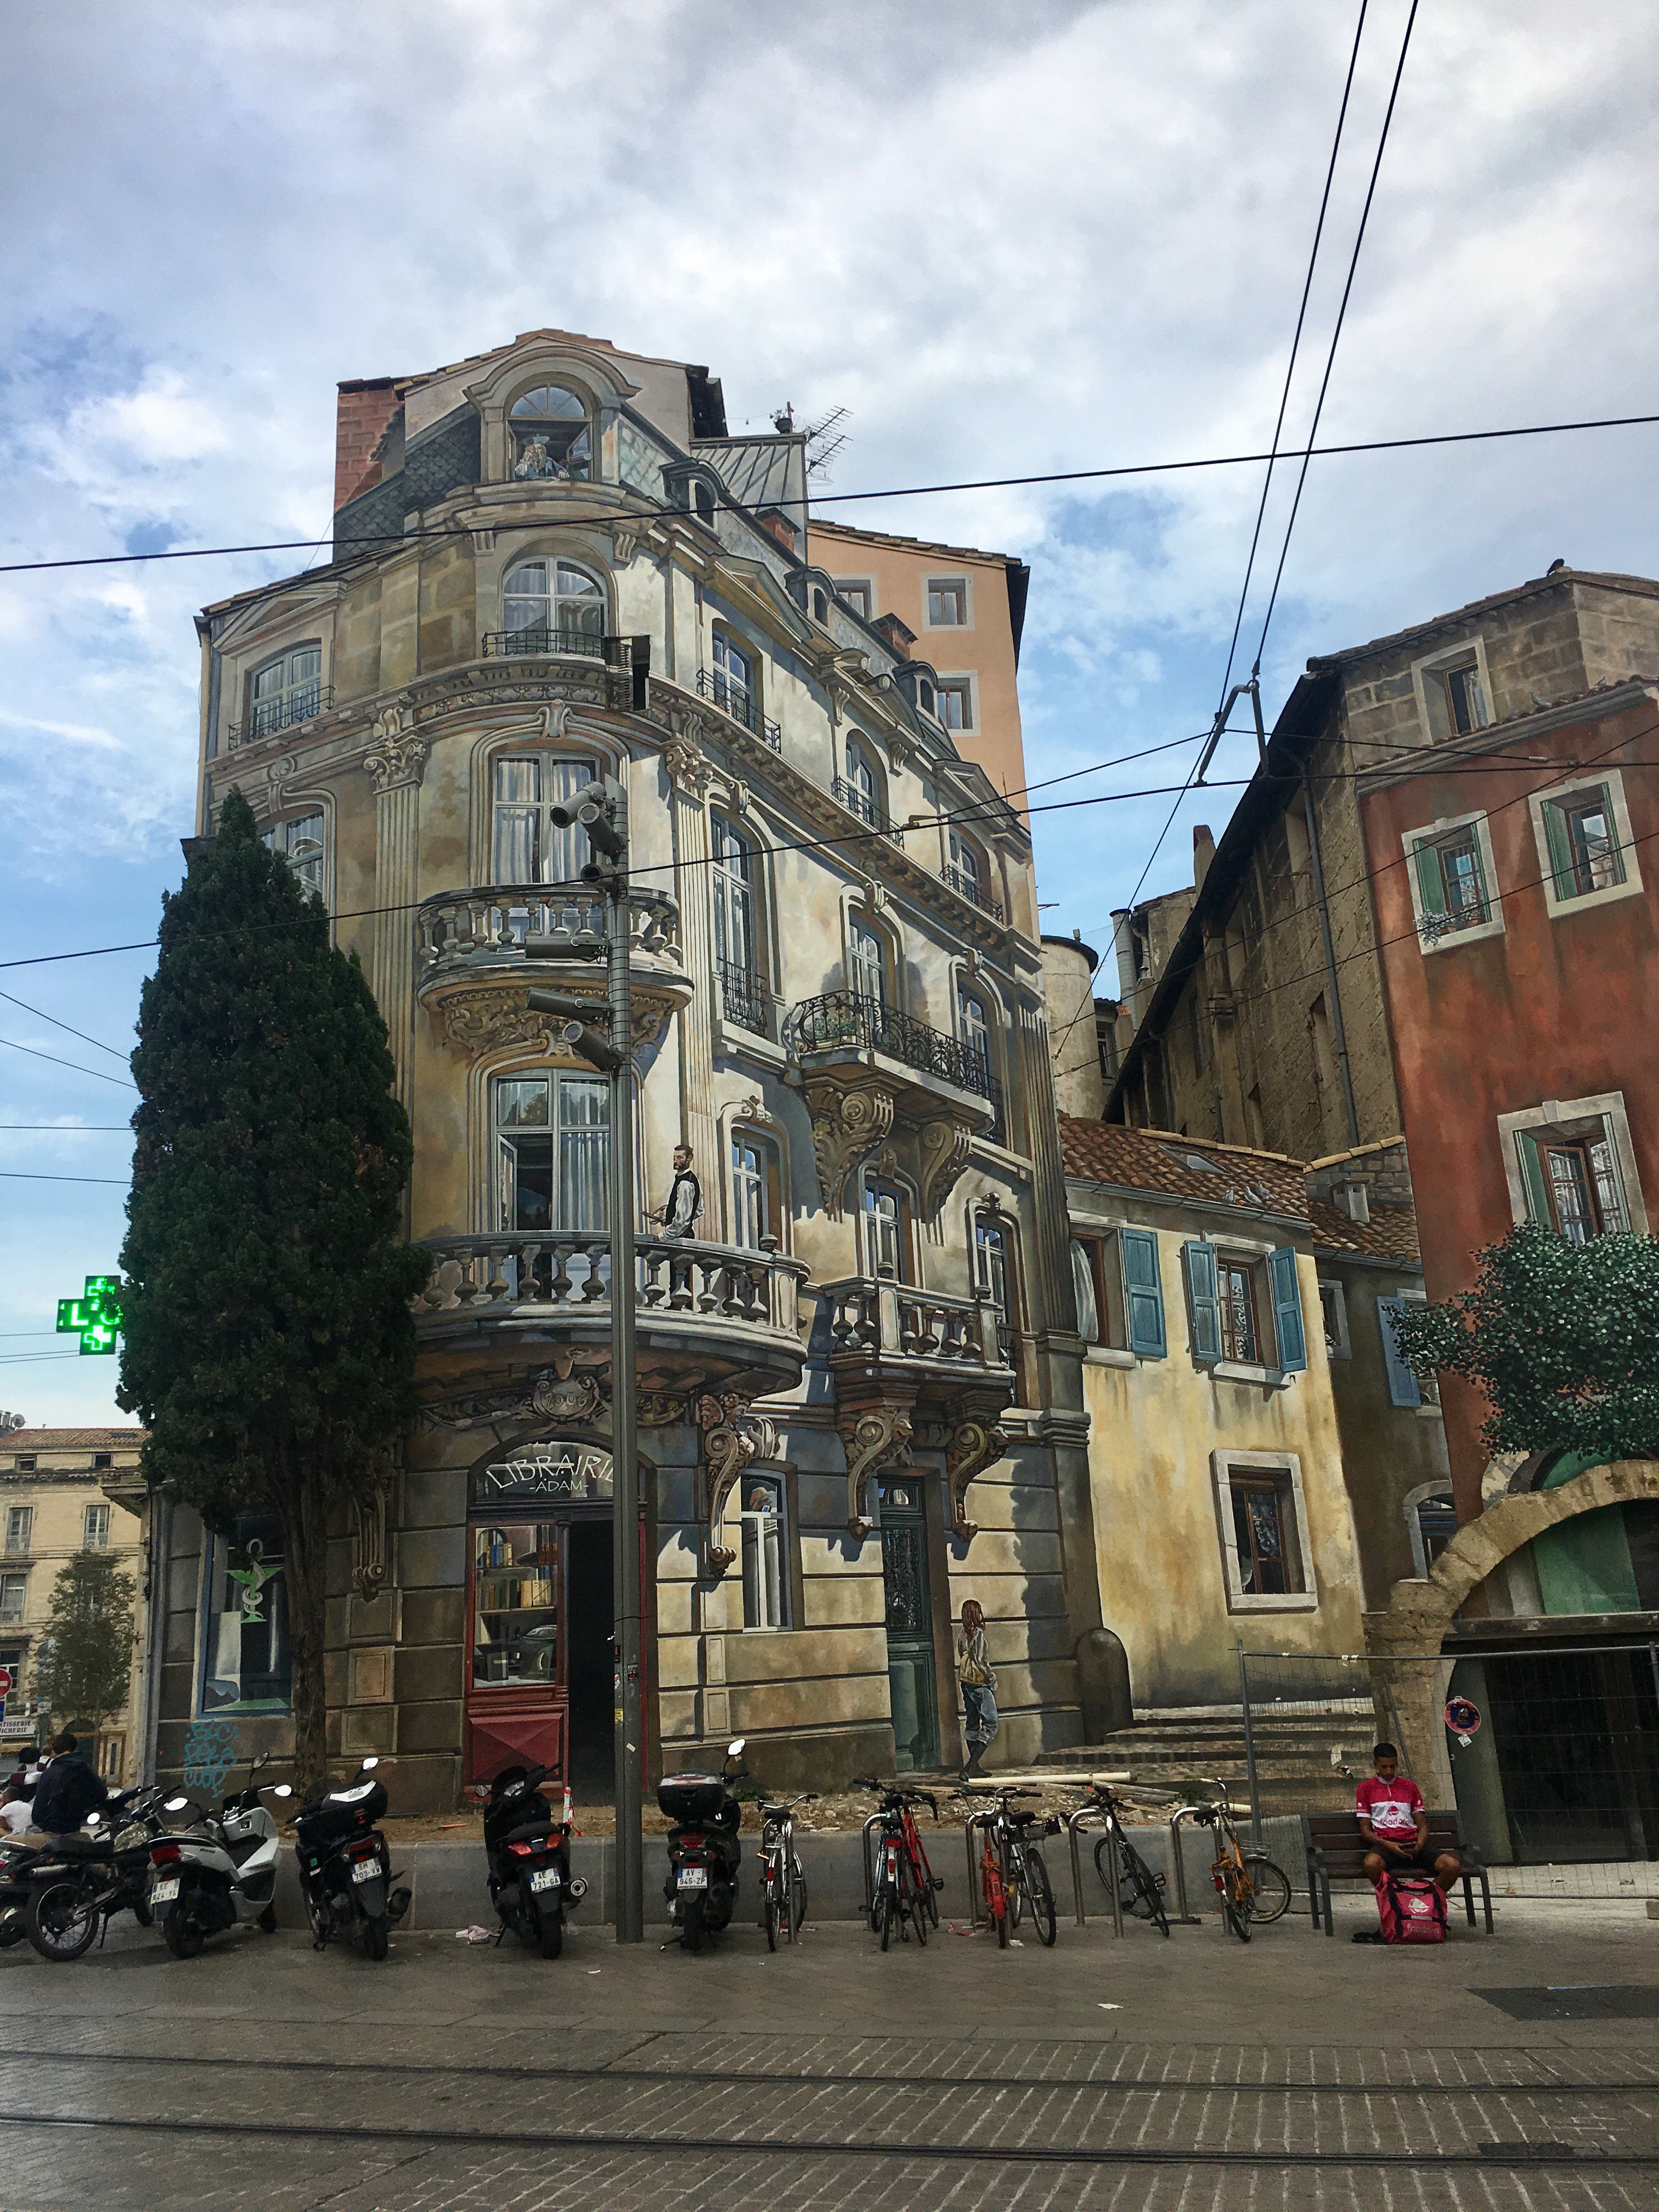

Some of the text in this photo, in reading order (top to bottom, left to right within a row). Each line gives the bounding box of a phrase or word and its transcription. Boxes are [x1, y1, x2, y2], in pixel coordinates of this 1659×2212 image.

[545, 1392, 588, 1410] 2006
[538, 1871, 546, 1880] AE
[533, 1877, 558, 1889] 721-GA
[679, 1877, 706, 1885] 945-ZP
